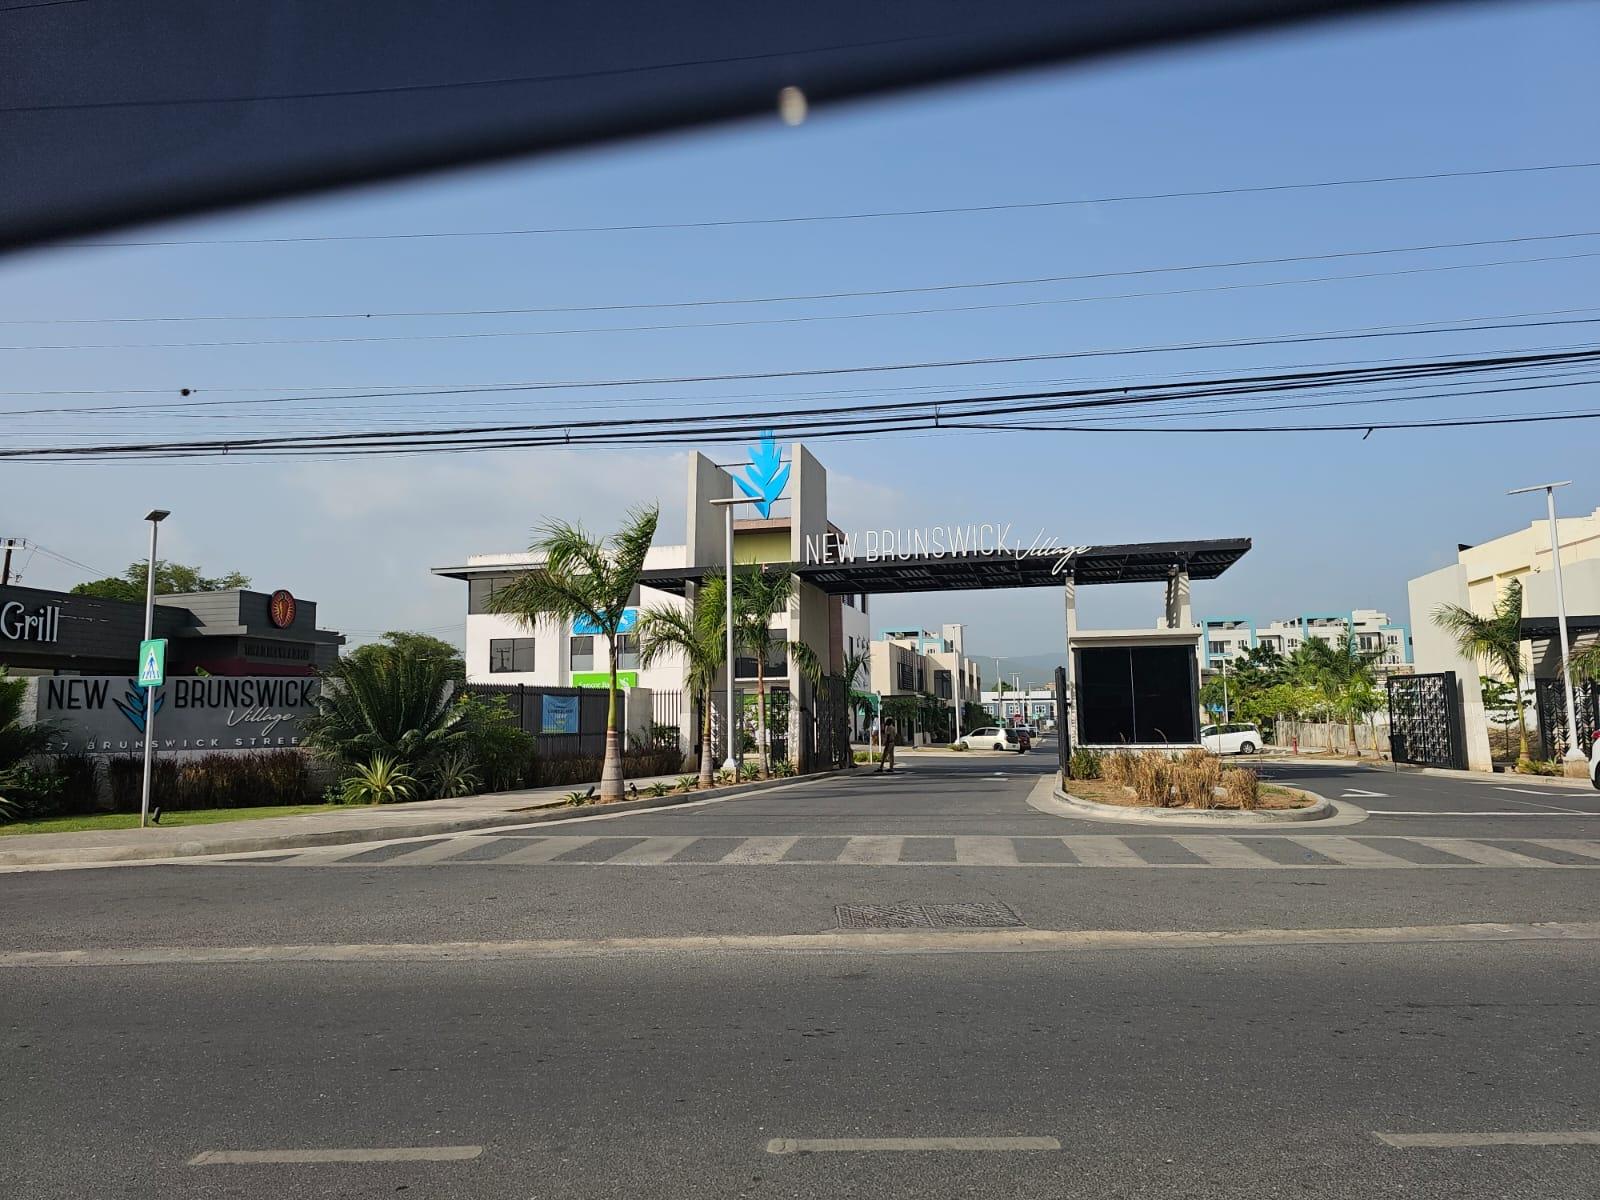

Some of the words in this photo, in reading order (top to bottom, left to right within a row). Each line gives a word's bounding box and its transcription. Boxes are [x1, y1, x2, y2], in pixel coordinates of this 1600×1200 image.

[805, 532, 858, 565] NEW
[866, 522, 1013, 562] BRUNSWICK
[1015, 528, 1092, 576] Village
[0, 601, 60, 642] Grill
[47, 679, 110, 710] NEW
[174, 679, 314, 709] BRUNSWICK
[227, 703, 296, 737] Village
[87, 739, 219, 750] BRUNSWICK
[235, 737, 300, 746] STREE
